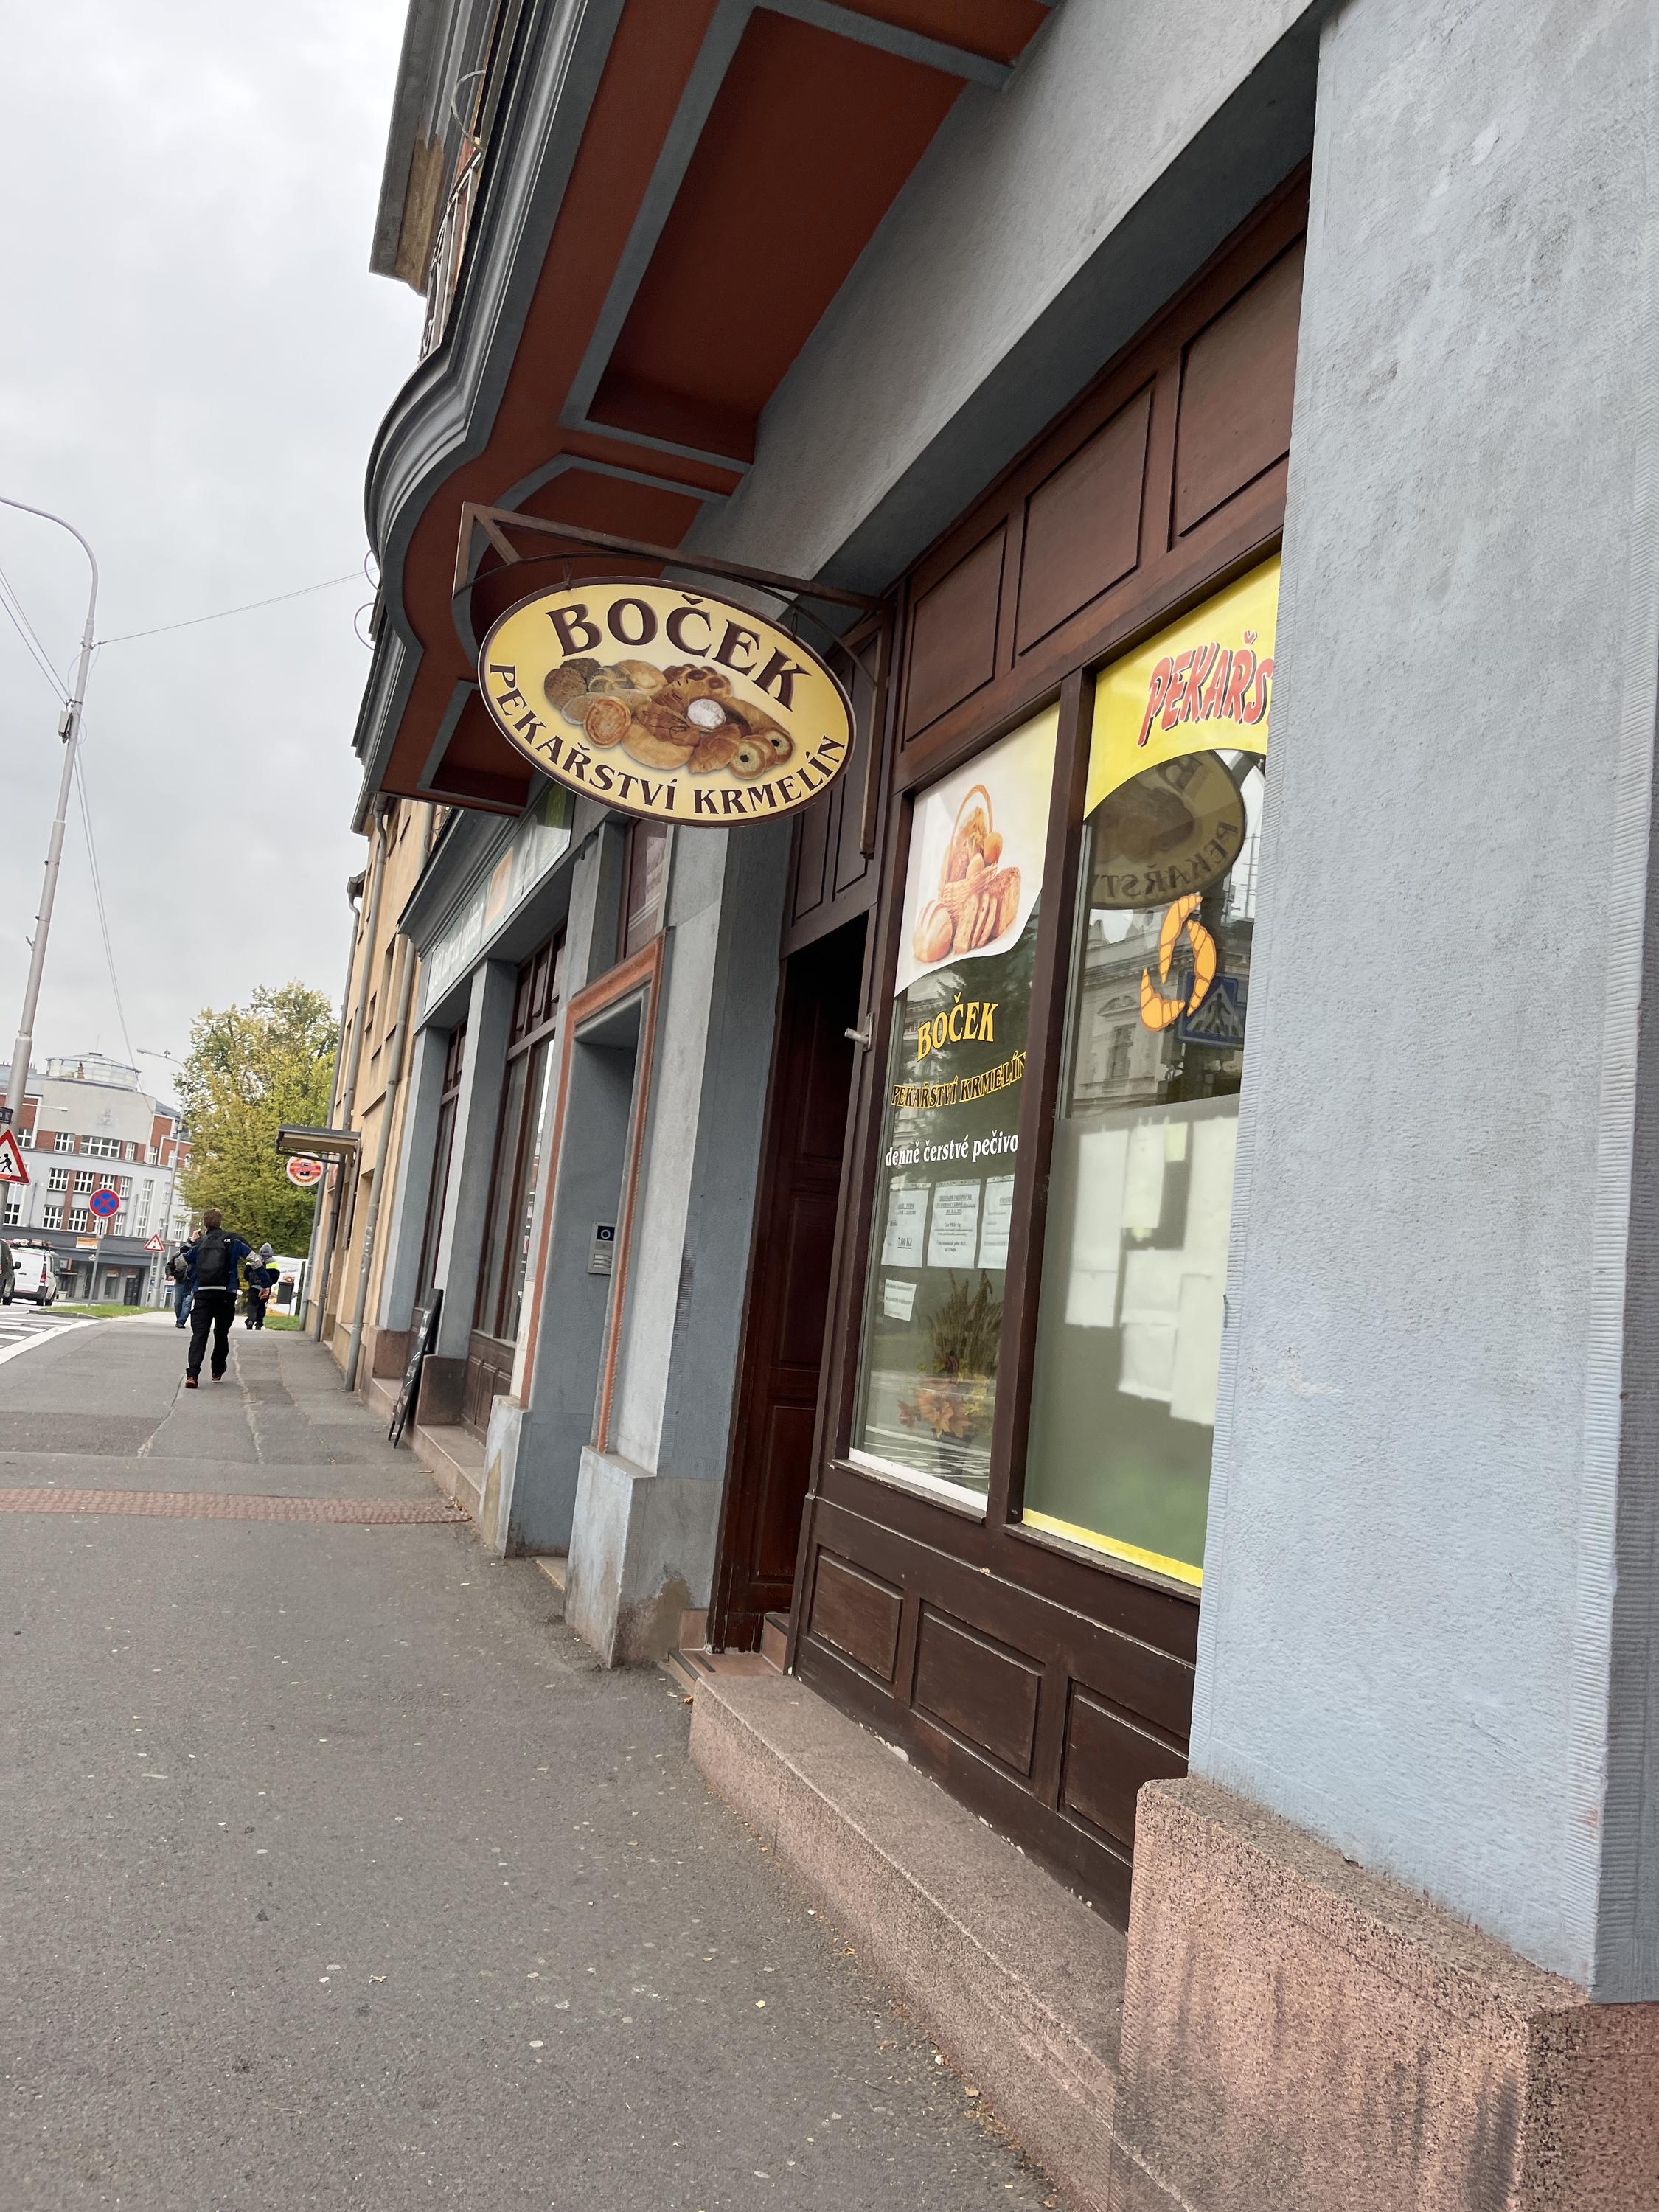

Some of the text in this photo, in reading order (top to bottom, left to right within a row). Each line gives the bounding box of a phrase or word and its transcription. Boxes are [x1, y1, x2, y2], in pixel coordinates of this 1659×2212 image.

[546, 594, 812, 712] BOČEK
[1138, 630, 1275, 748] PEKAŘS
[490, 663, 846, 815] PEKAŘSTVÍ KRMELÍN
[917, 992, 999, 1062] BOČEK
[891, 1075, 959, 1109] PEKAŘSTVÍ
[886, 1130, 1019, 1166] denně čerstvé pečivo
